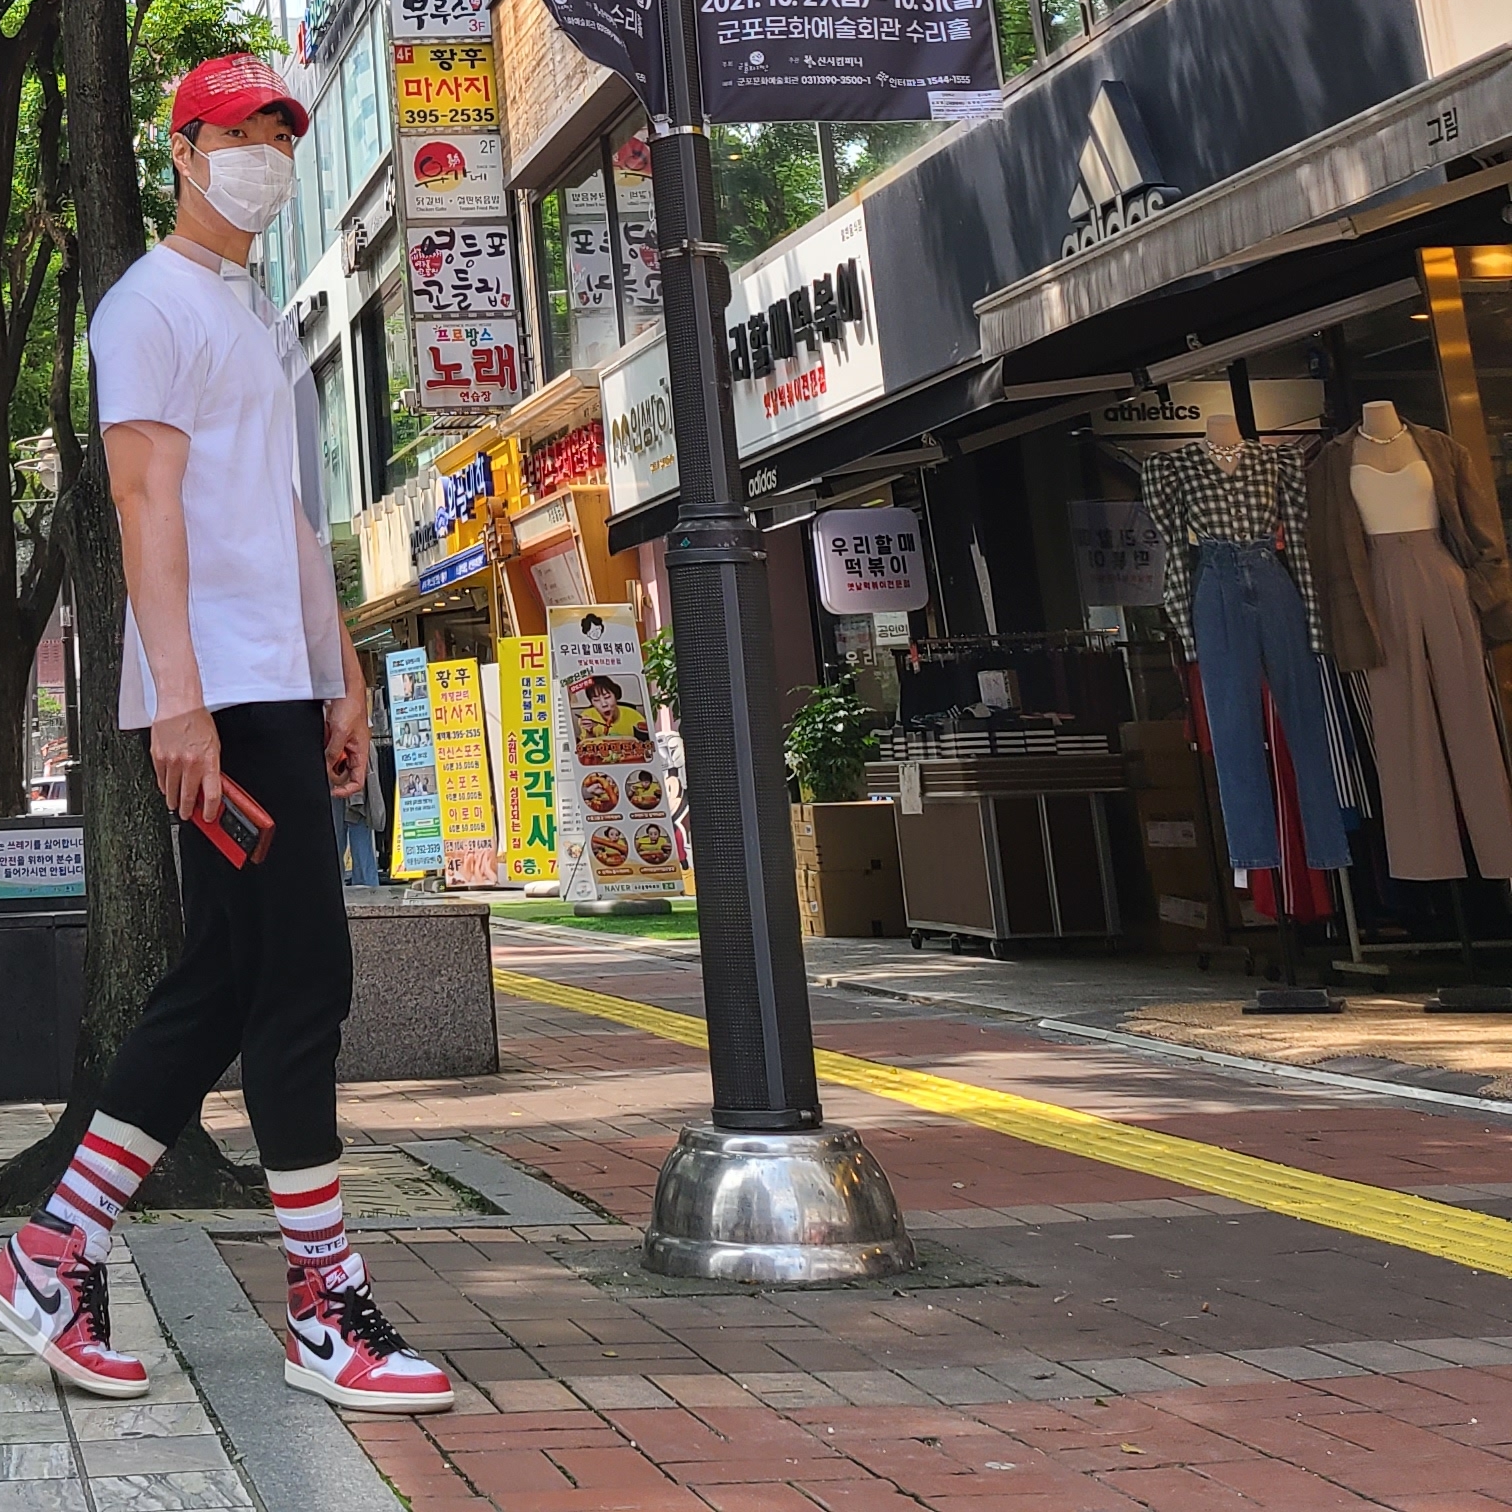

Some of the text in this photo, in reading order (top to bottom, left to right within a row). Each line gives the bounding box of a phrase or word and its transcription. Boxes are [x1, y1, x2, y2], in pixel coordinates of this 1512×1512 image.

[468, 18, 486, 32] 3F
[716, 15, 972, 45] 군포문화예술회관 수리홀
[395, 45, 413, 61] 4F
[429, 47, 487, 72] 황후
[403, 74, 491, 103] 마사지
[888, 76, 926, 88] 인터파크
[404, 107, 496, 125] 395-2535
[1425, 107, 1458, 148] 그림
[479, 139, 496, 155] 2F
[414, 155, 487, 189] 유가네
[415, 196, 444, 206] 닭갈비
[420, 227, 508, 268] 영등포
[728, 255, 864, 381] 리할매떡볶이
[436, 327, 494, 348] 프로방스
[424, 343, 518, 392] 노래
[459, 390, 492, 404] 연습장
[1103, 400, 1201, 423] athletics
[747, 467, 778, 496] adidas
[831, 533, 916, 557] 우리할매
[844, 555, 908, 579] 떡볶이
[559, 642, 635, 656] 우리할매떡볶이
[844, 649, 878, 668] 우리
[435, 667, 471, 689] 황후
[434, 702, 478, 725] 마사지
[437, 743, 482, 761] 전신스포츠
[507, 730, 519, 765] 소원이
[446, 775, 480, 790] 스포츠
[519, 726, 557, 853] 정각사
[448, 806, 483, 821] 아로마
[7, 839, 41, 851] 쓰레기를
[0, 855, 25, 867] 안전을
[27, 854, 54, 865] 위하여
[56, 853, 82, 865] 분수를
[447, 858, 462, 872] 4F
[4, 866, 47, 879] 들어가시면
[603, 884, 631, 893] NAVER
